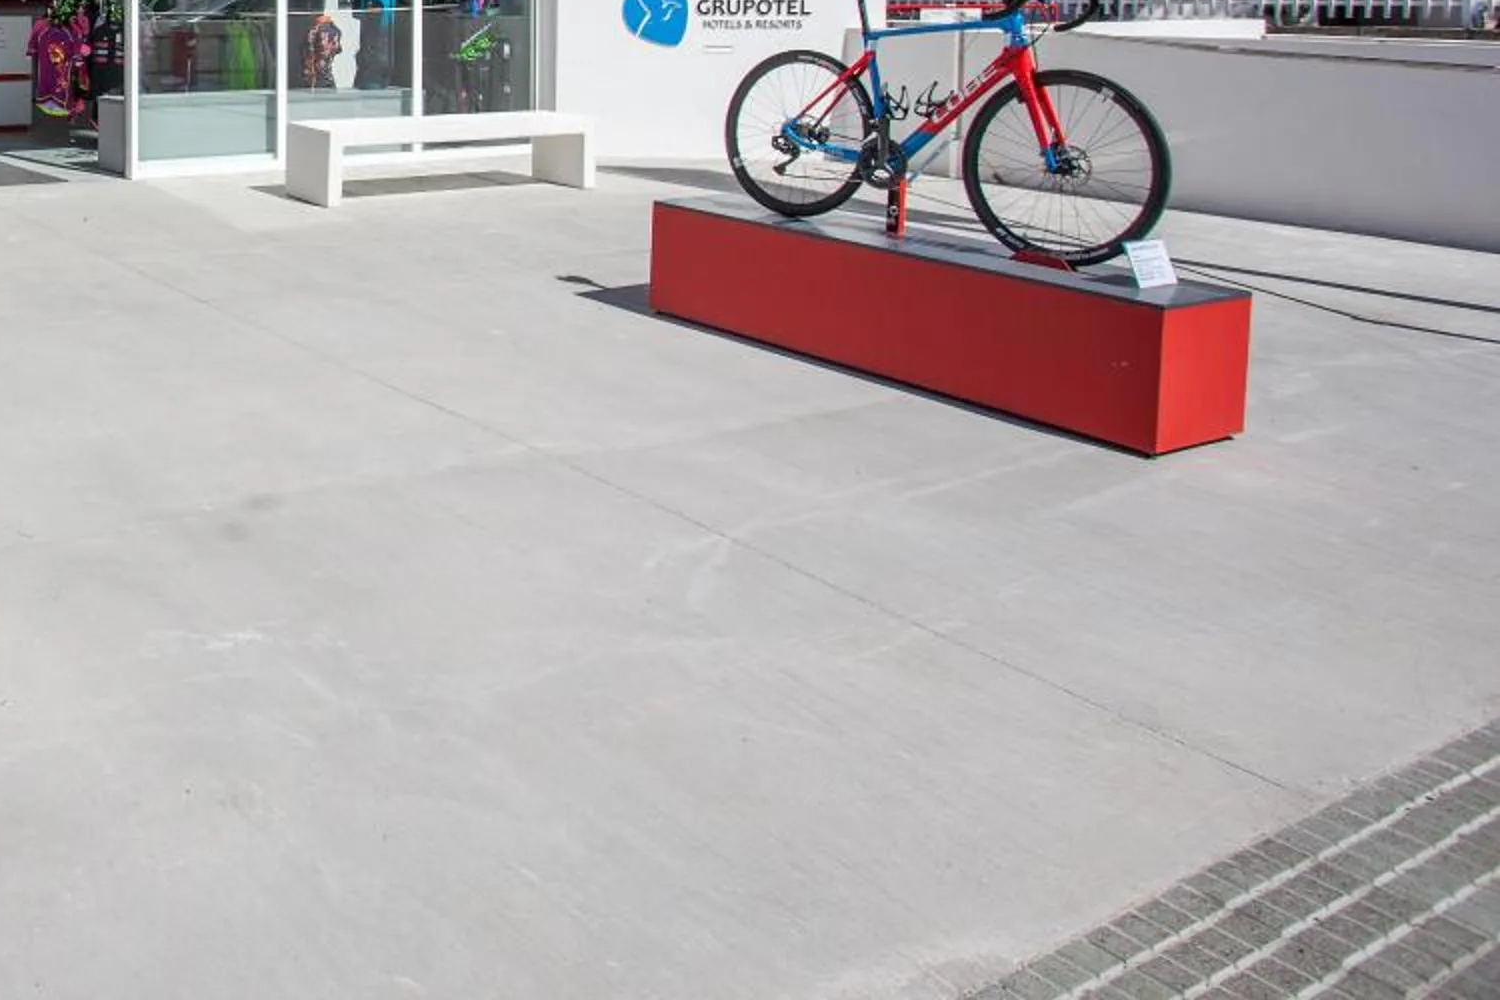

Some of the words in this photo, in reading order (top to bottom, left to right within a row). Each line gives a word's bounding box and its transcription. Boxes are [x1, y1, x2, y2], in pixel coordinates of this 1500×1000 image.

[702, 18, 742, 30] HOTELS
[744, 19, 753, 29] &
[755, 18, 803, 30] RESORTS
